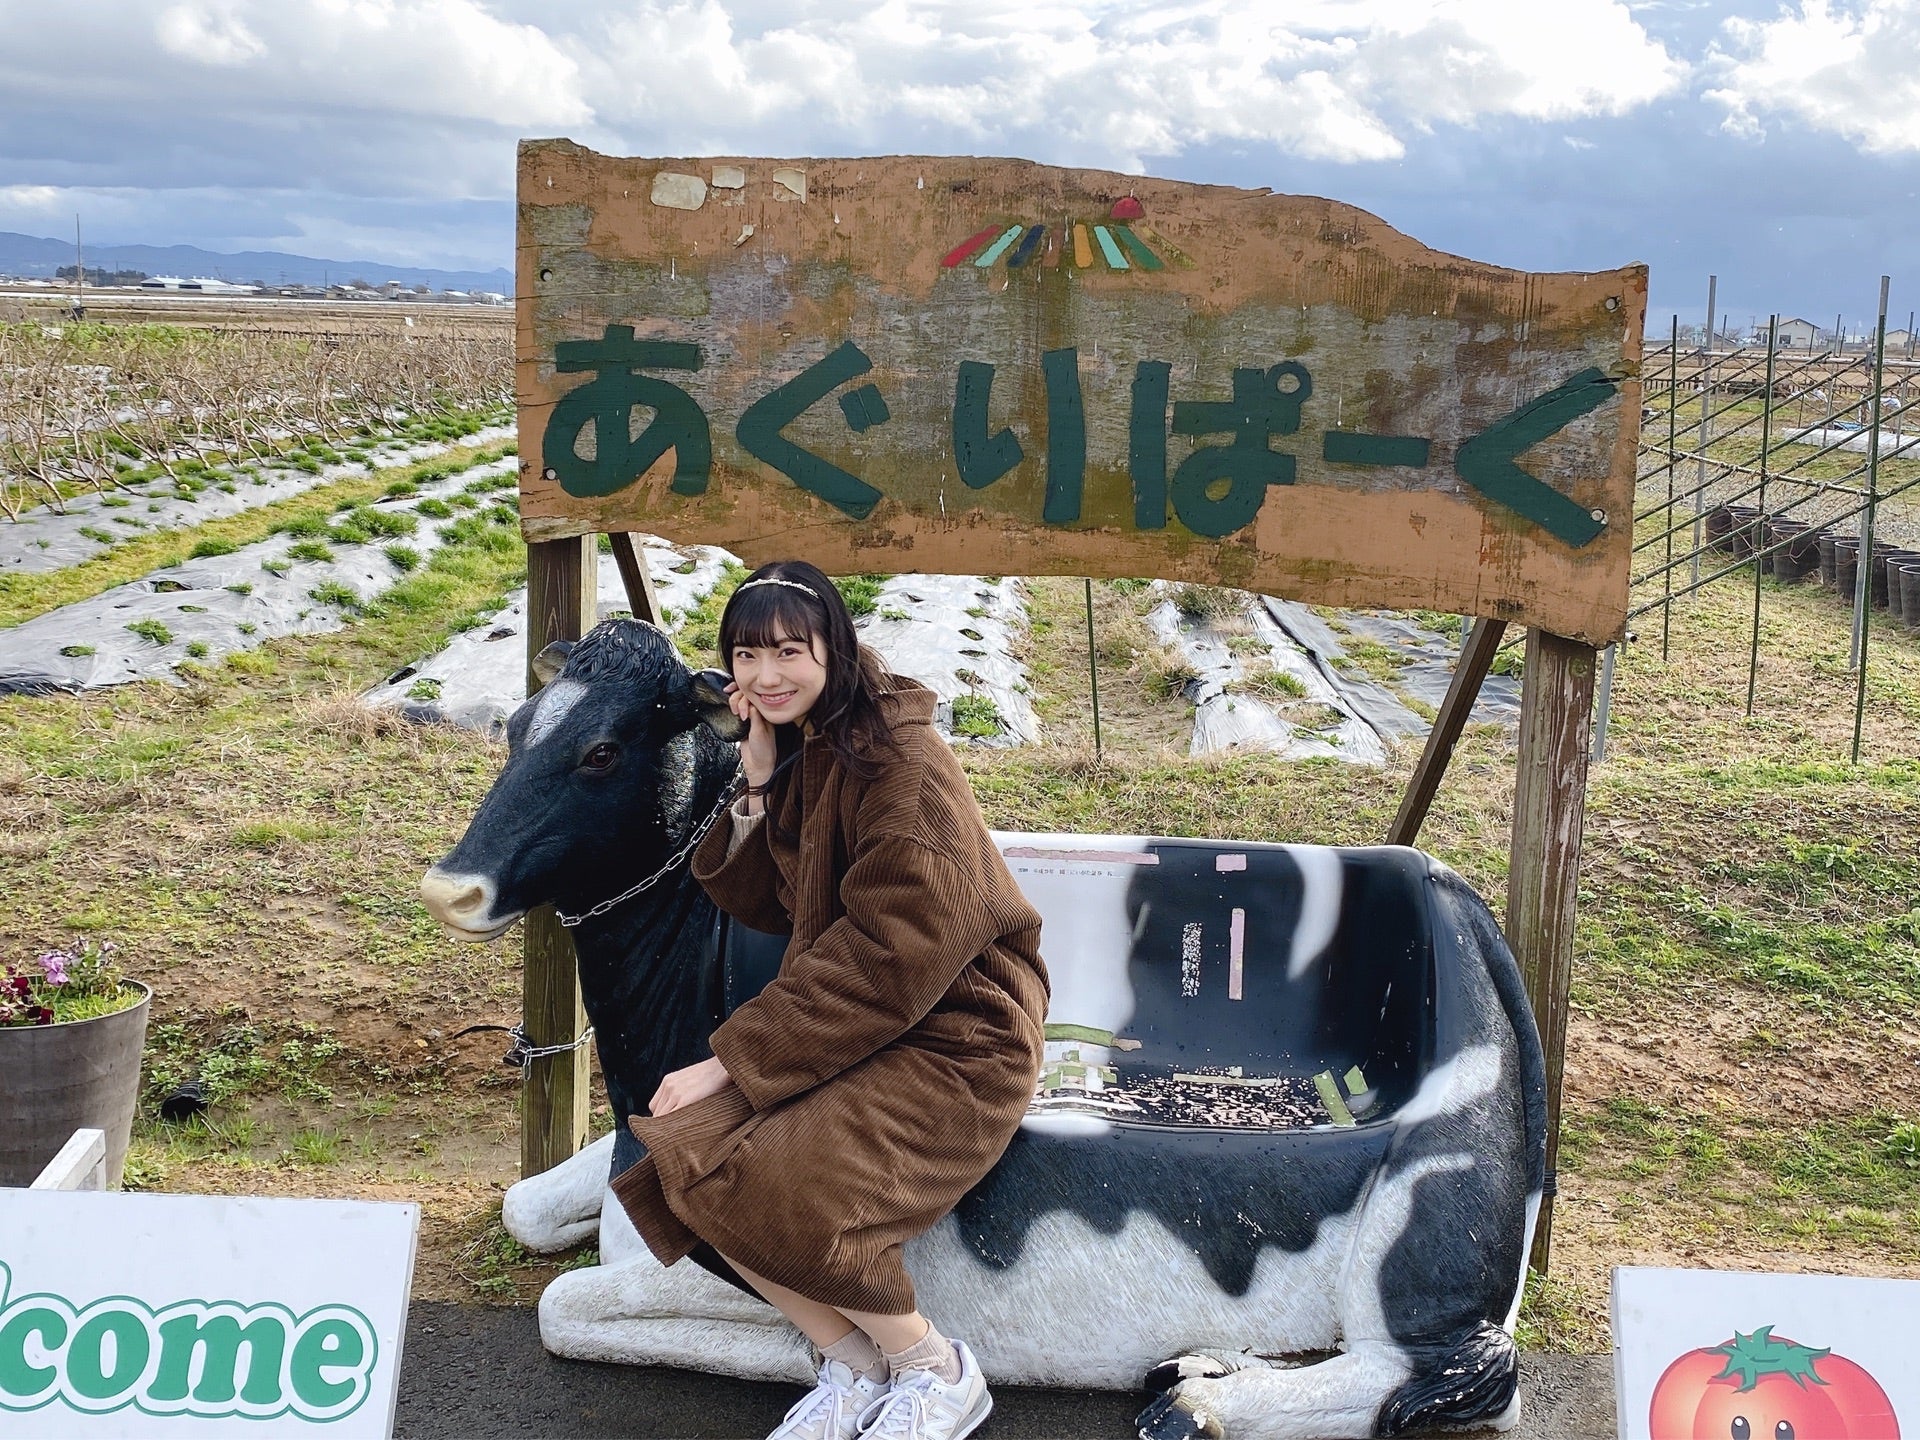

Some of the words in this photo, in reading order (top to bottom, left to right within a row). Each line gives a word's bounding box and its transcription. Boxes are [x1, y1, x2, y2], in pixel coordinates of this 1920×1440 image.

[542, 324, 1617, 549] あぐりぱーく
[0, 1294, 378, 1422] come
